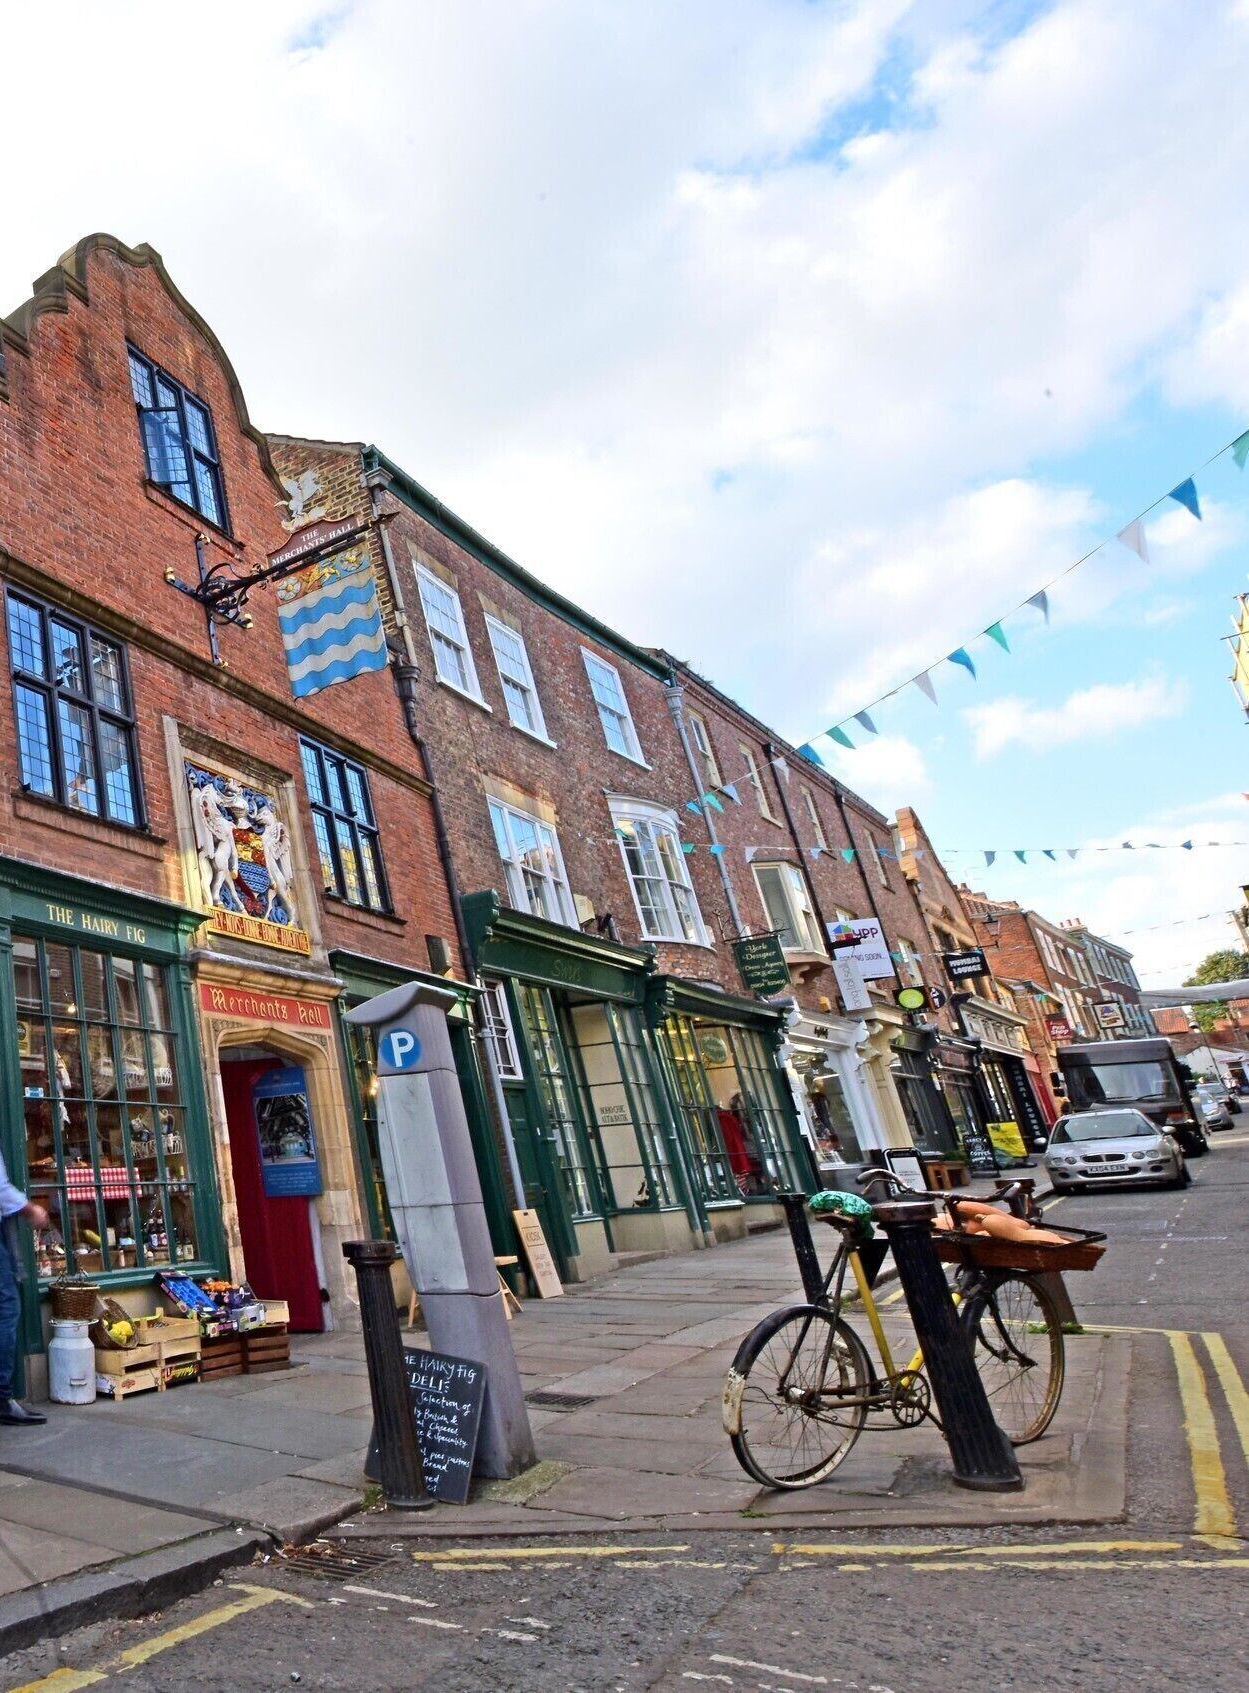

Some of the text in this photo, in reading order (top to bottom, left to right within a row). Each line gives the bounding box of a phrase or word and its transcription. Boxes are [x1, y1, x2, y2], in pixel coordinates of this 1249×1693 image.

[301, 528, 319, 542] THE
[329, 524, 353, 540] HALL
[46, 904, 146, 943] THE HAIRY FIG
[953, 964, 982, 974] LOUNGE
[209, 987, 288, 1020] Merchants
[390, 1031, 414, 1067] P
[420, 1355, 455, 1380] HAIRY
[411, 1373, 443, 1392] DELI
